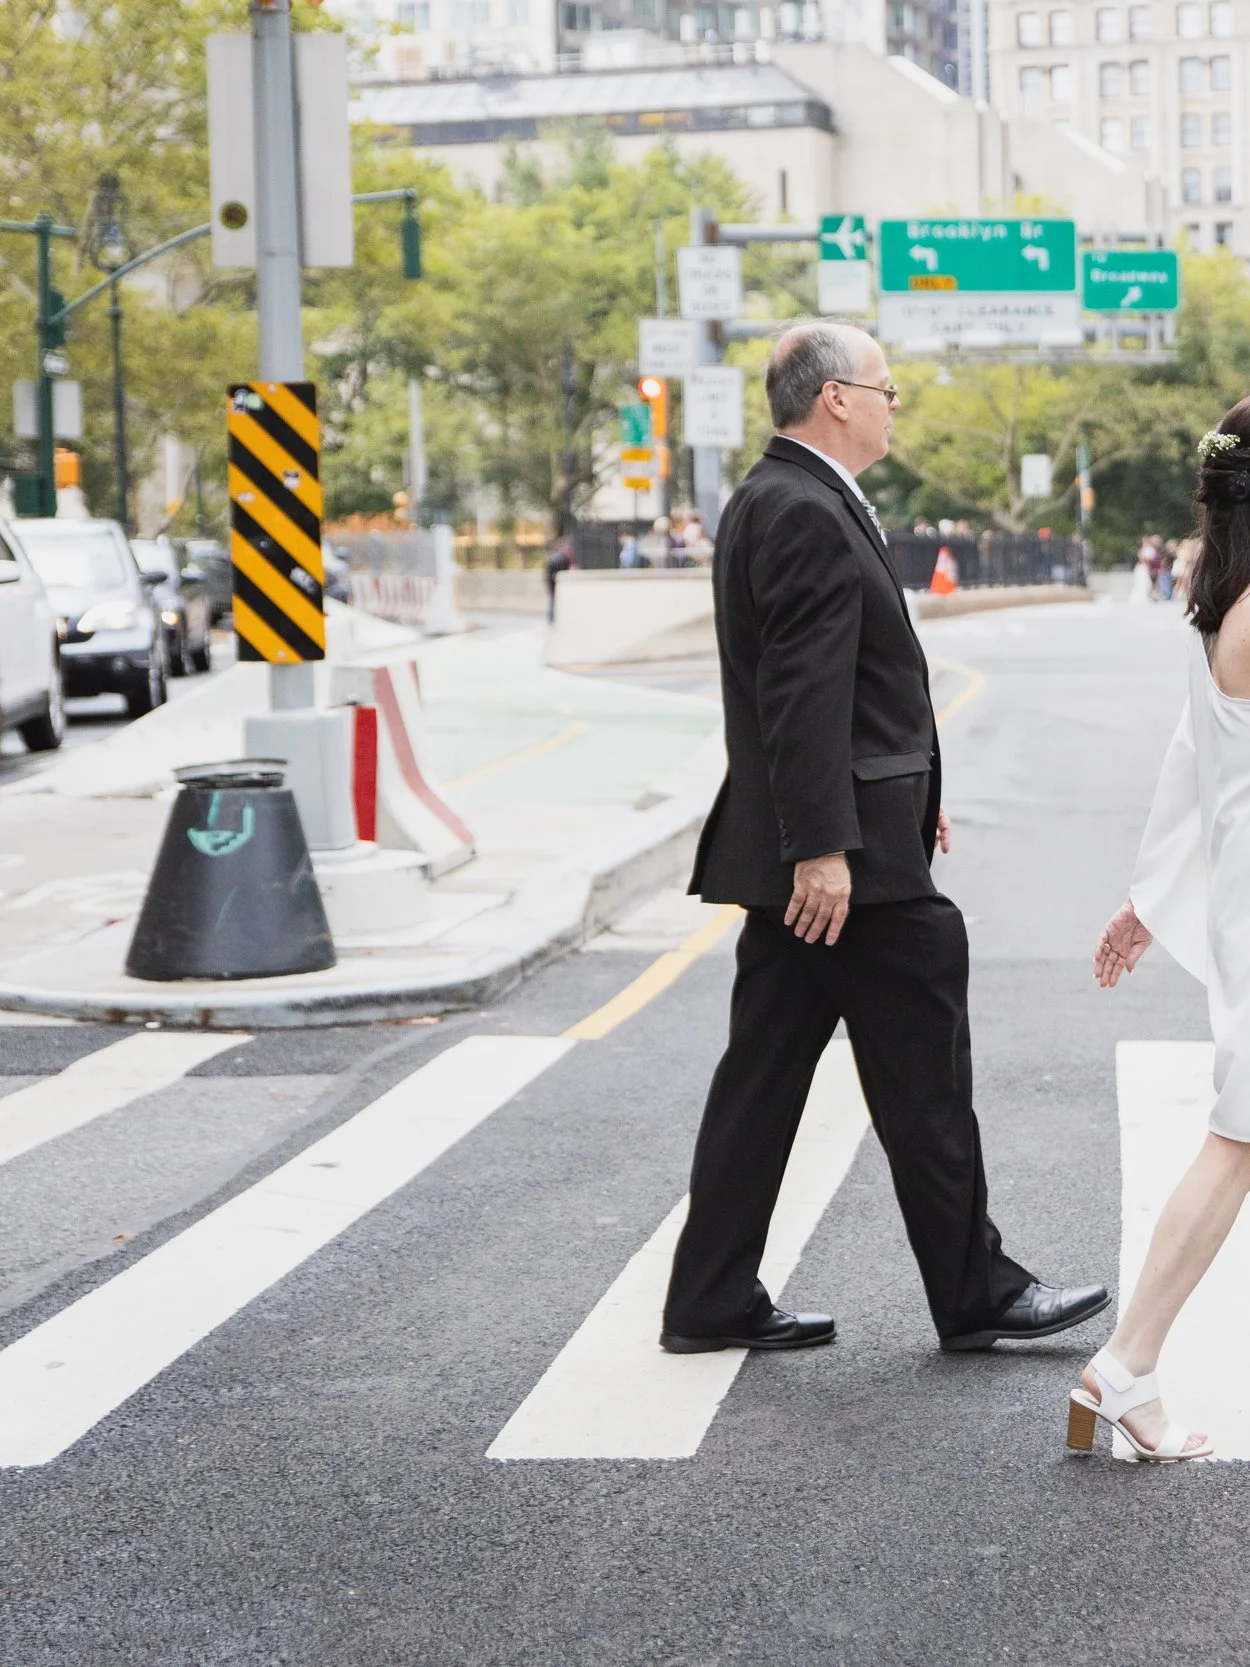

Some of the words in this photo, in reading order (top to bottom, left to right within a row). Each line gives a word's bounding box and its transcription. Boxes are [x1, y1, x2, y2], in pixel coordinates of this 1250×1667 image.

[907, 220, 1007, 241] Brooklyn
[1020, 220, 1043, 240] Br
[1090, 268, 1168, 284] Broadway
